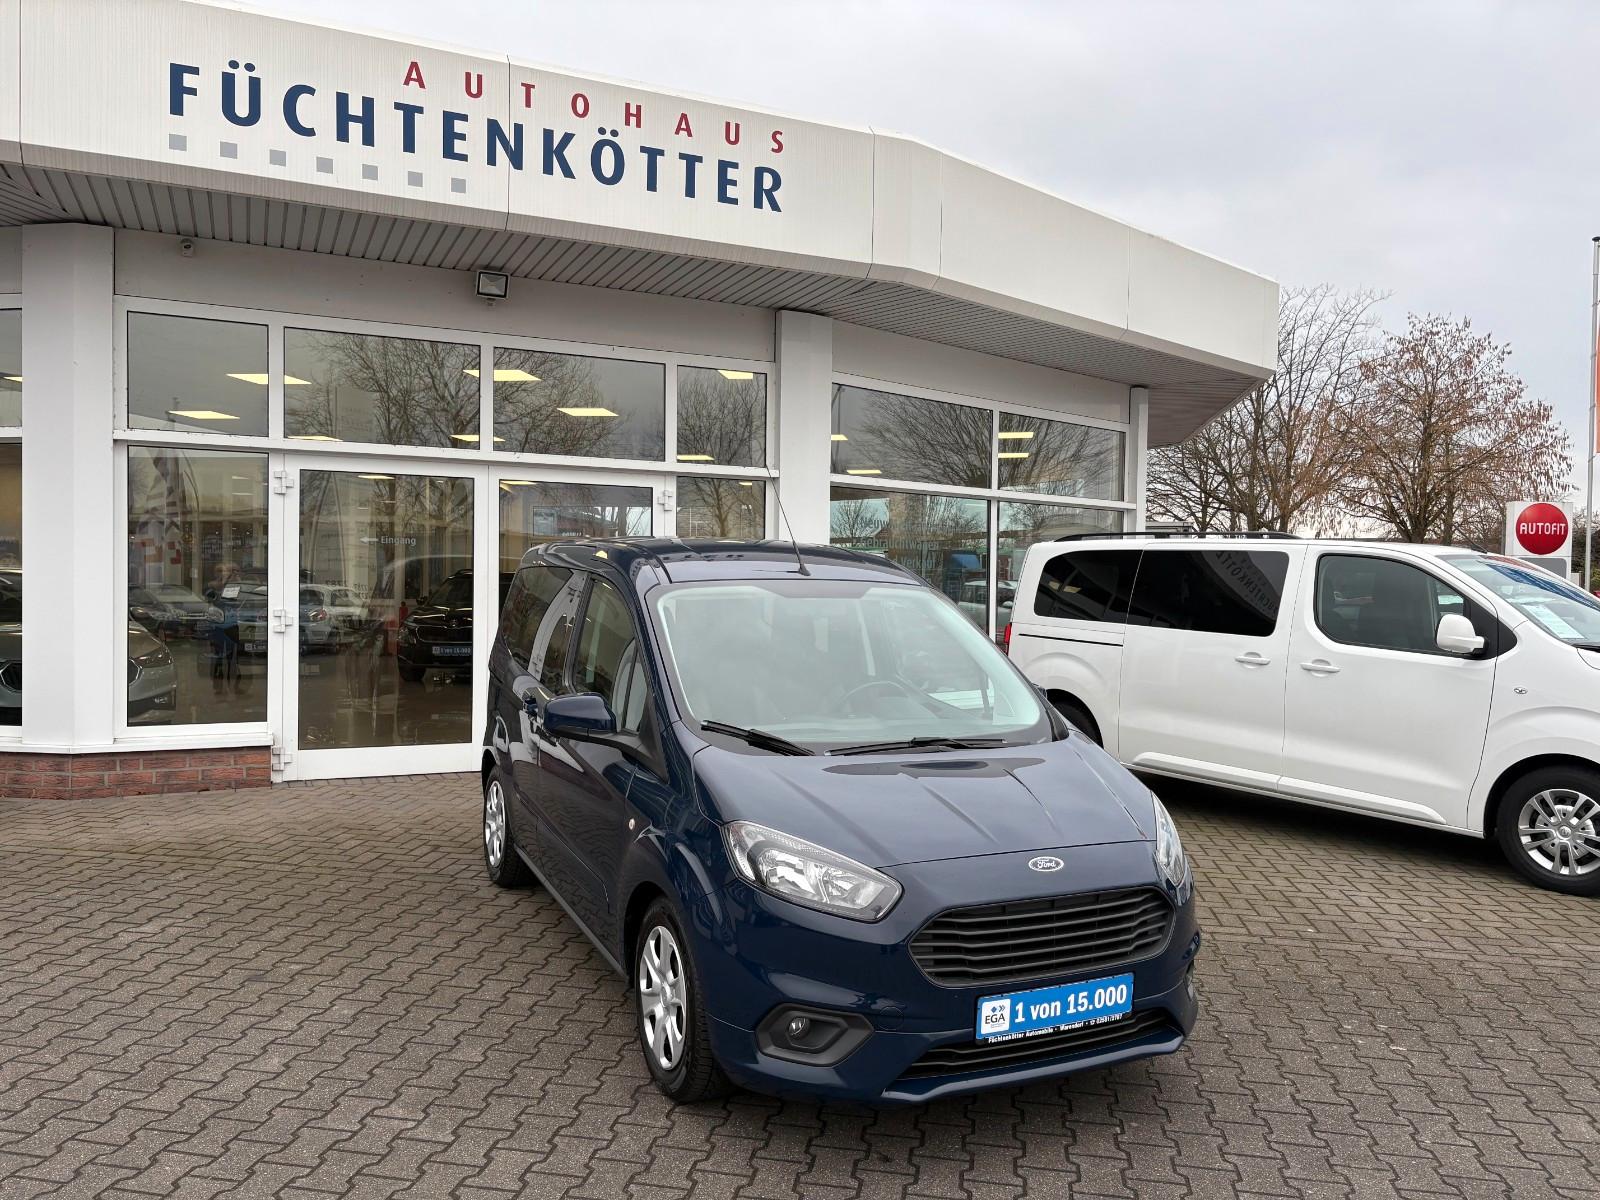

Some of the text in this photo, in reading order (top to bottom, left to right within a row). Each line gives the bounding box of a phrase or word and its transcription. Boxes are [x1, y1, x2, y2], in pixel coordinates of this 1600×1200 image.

[403, 61, 784, 154] AUTOHAUS
[169, 59, 783, 212] FÜCHTENKÖTTER
[1519, 522, 1566, 535] AUTOFIT
[381, 535, 416, 546] Eingang
[1037, 859, 1056, 868] Ford
[1014, 984, 1128, 1023] 1 von 15.000
[985, 1013, 1006, 1025] EGA
